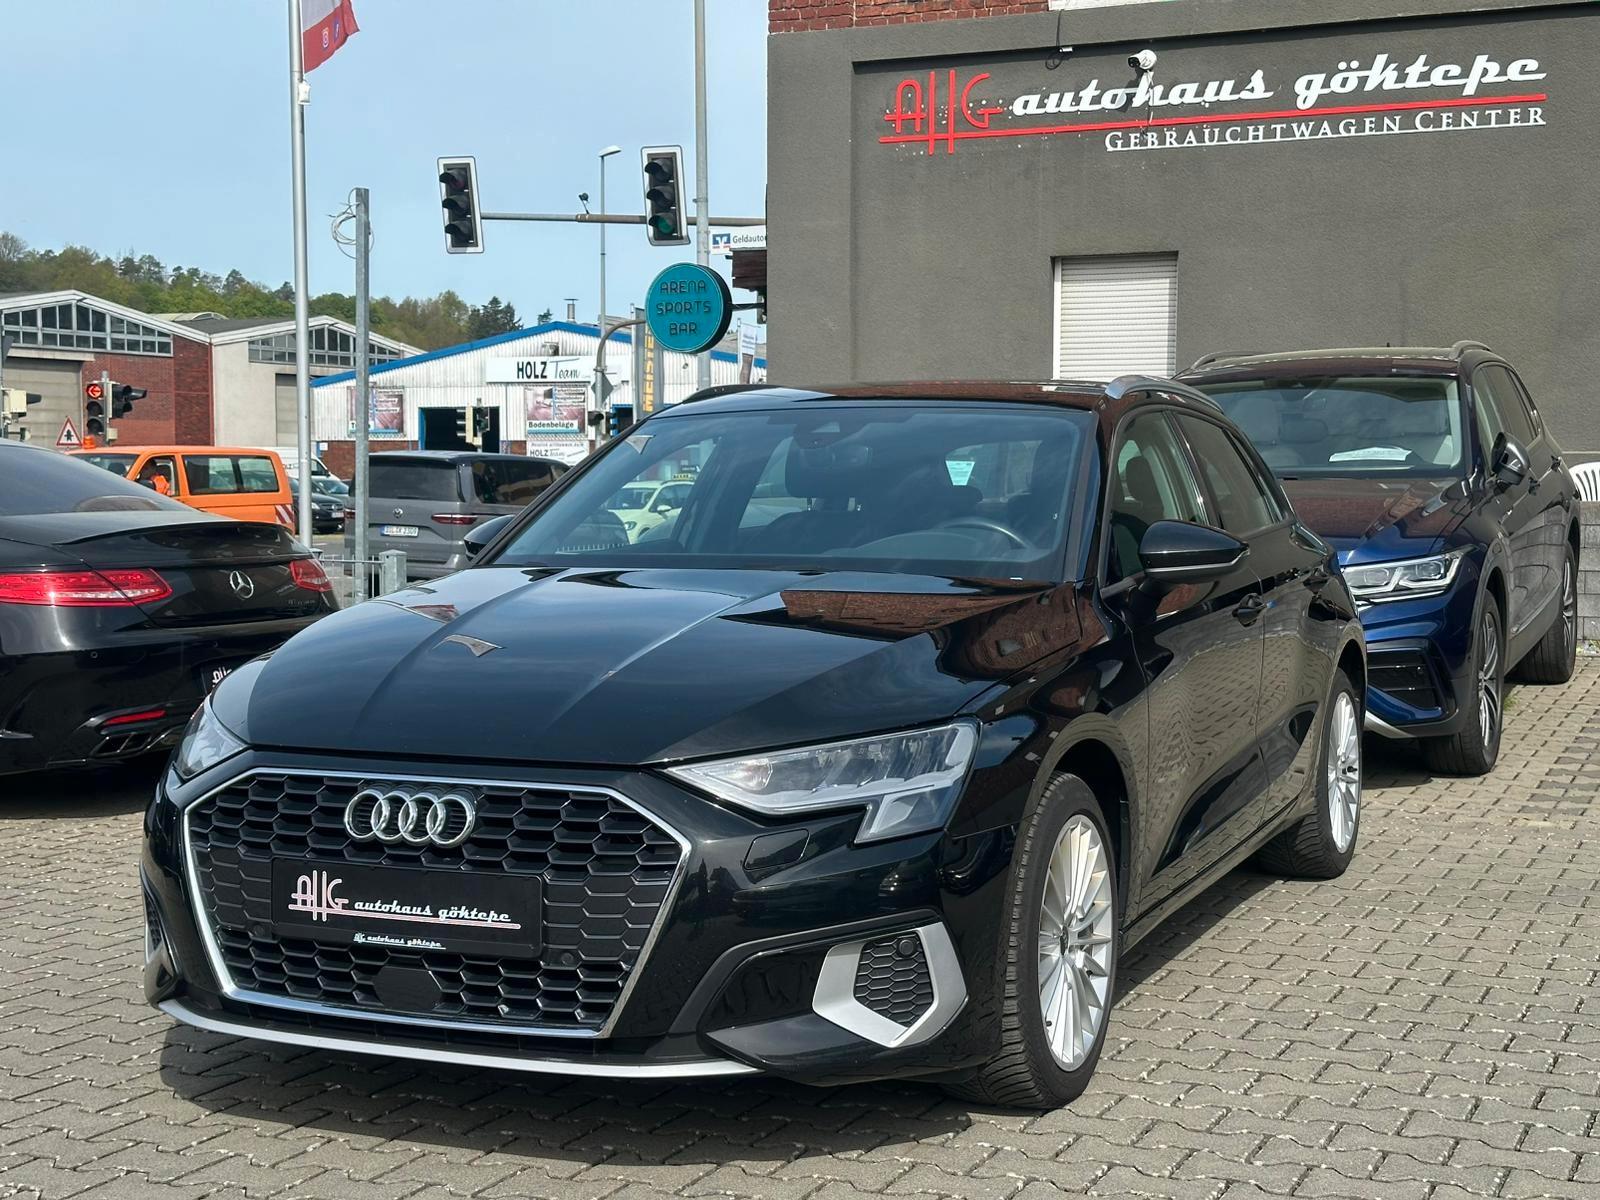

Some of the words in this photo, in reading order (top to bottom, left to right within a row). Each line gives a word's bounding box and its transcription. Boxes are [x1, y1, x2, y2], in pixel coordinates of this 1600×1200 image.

[1012, 69, 1274, 117] autohaus
[1293, 53, 1547, 110] göktepe
[1414, 107, 1546, 132] CENTER
[660, 279, 707, 293] ARENA
[656, 300, 711, 315] SPORTS
[669, 322, 697, 336] BAR
[517, 361, 547, 379] HOLZ
[354, 900, 433, 917] autohaus
[438, 907, 511, 924] göktepe
[367, 935, 405, 944] autohaus
